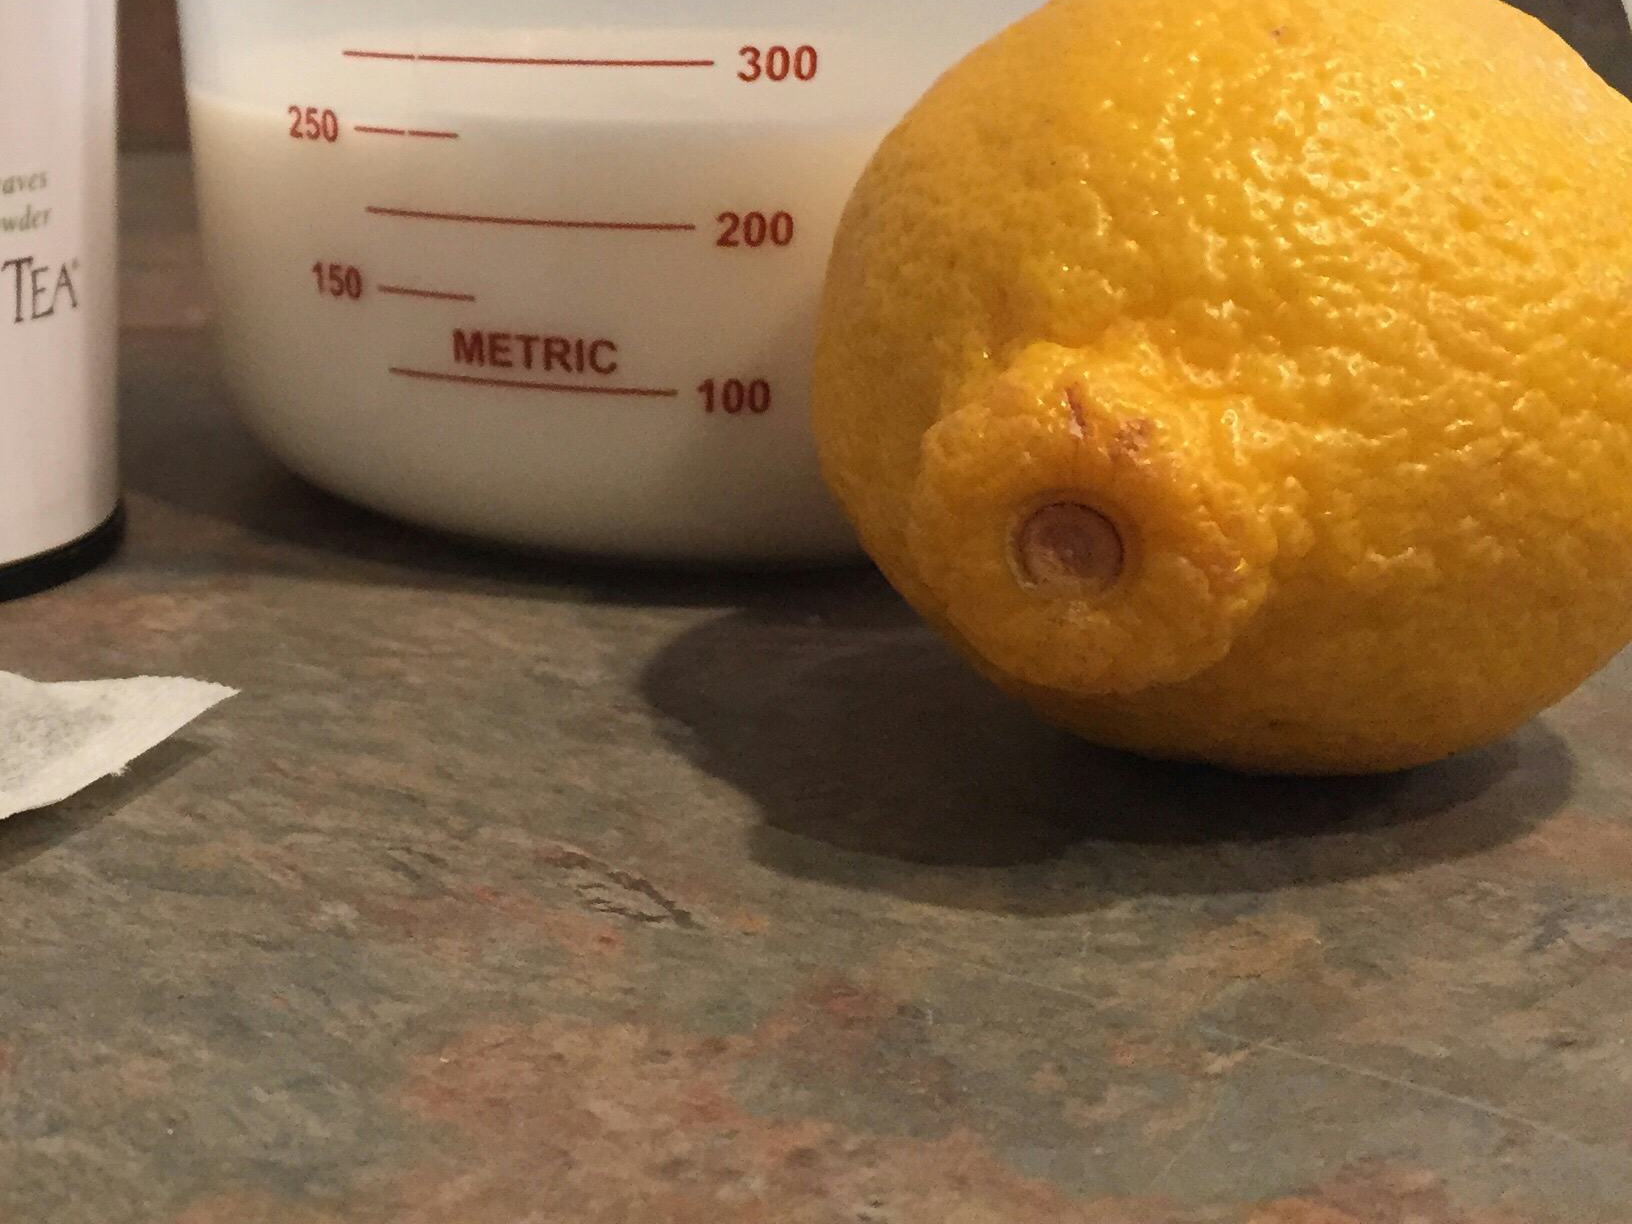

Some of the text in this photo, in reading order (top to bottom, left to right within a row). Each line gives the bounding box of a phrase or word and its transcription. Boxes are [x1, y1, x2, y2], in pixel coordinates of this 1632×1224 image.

[736, 45, 818, 83] 300
[287, 105, 339, 144] 250
[715, 211, 795, 248] 200
[311, 262, 363, 301] 150
[451, 329, 619, 376] METRIC
[698, 378, 772, 414] 100
